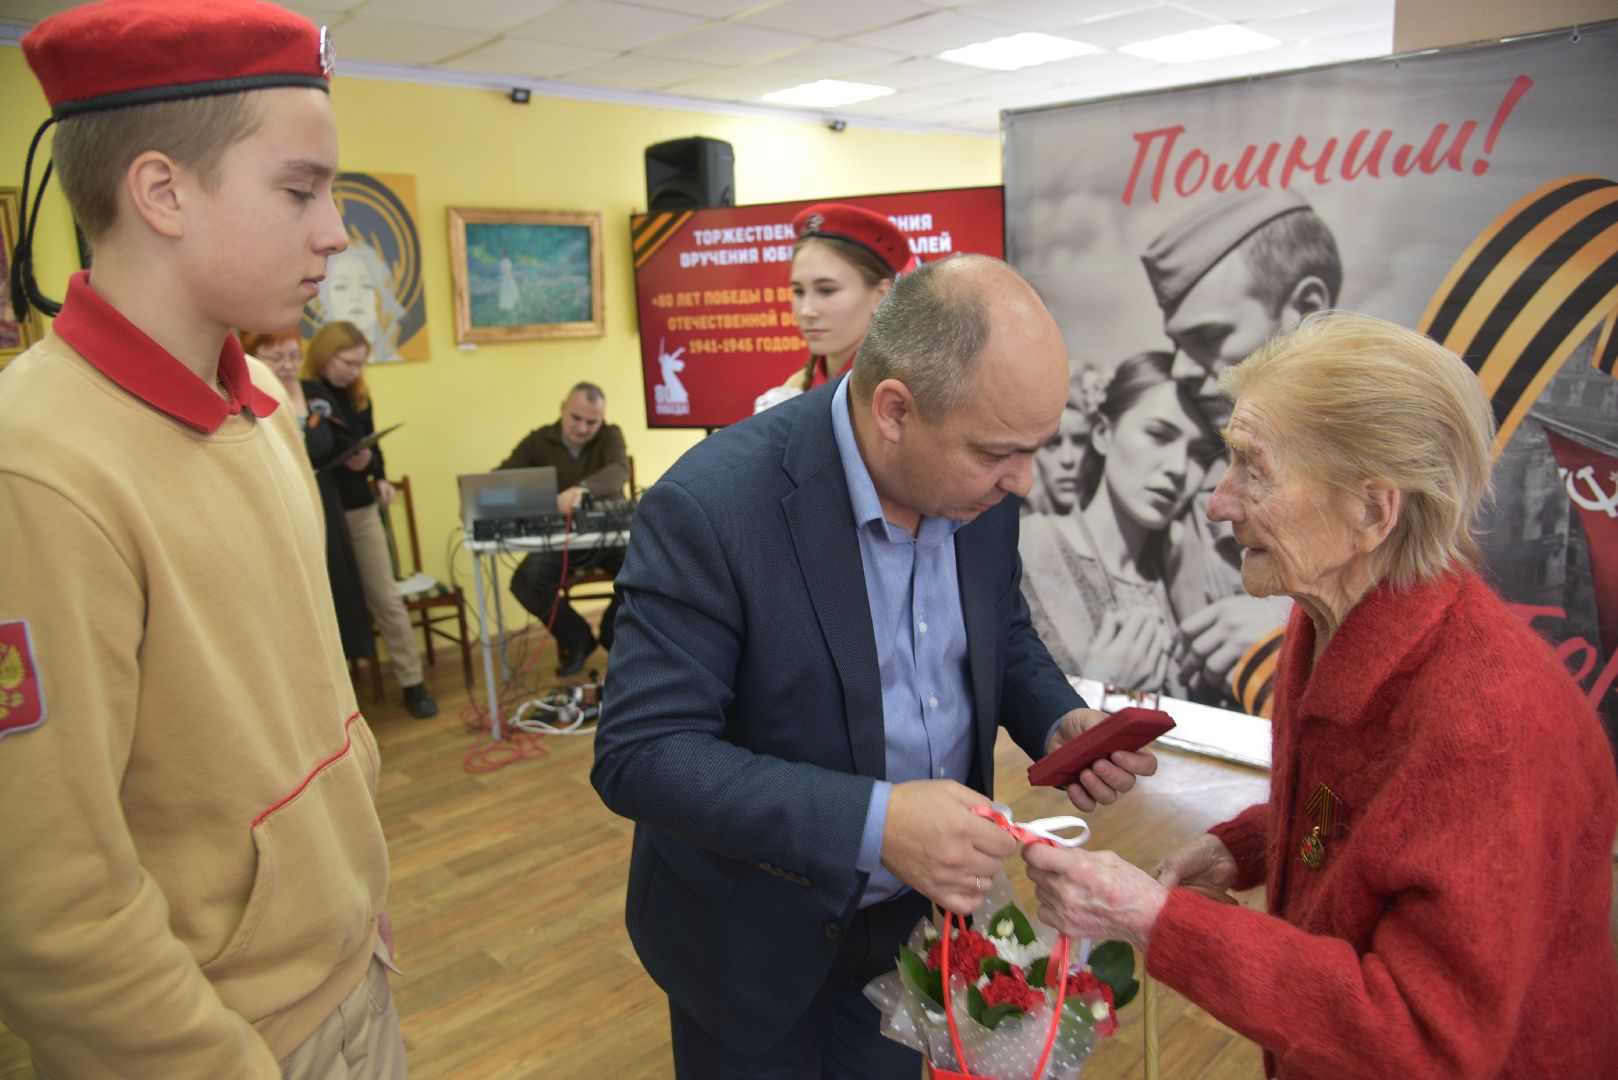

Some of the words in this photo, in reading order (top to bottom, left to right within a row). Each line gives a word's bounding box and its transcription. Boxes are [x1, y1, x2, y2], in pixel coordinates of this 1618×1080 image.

[1121, 75, 1534, 206] Помним!
[680, 247, 759, 268] ВРУЧЕНИЯ
[676, 291, 700, 307] ЛЕТ
[704, 288, 760, 306] ПОБЕДЫ
[763, 288, 774, 303] В
[667, 310, 777, 331] ОТЕЧЕСТВЕННОЙ
[689, 338, 753, 354] 1941-1945
